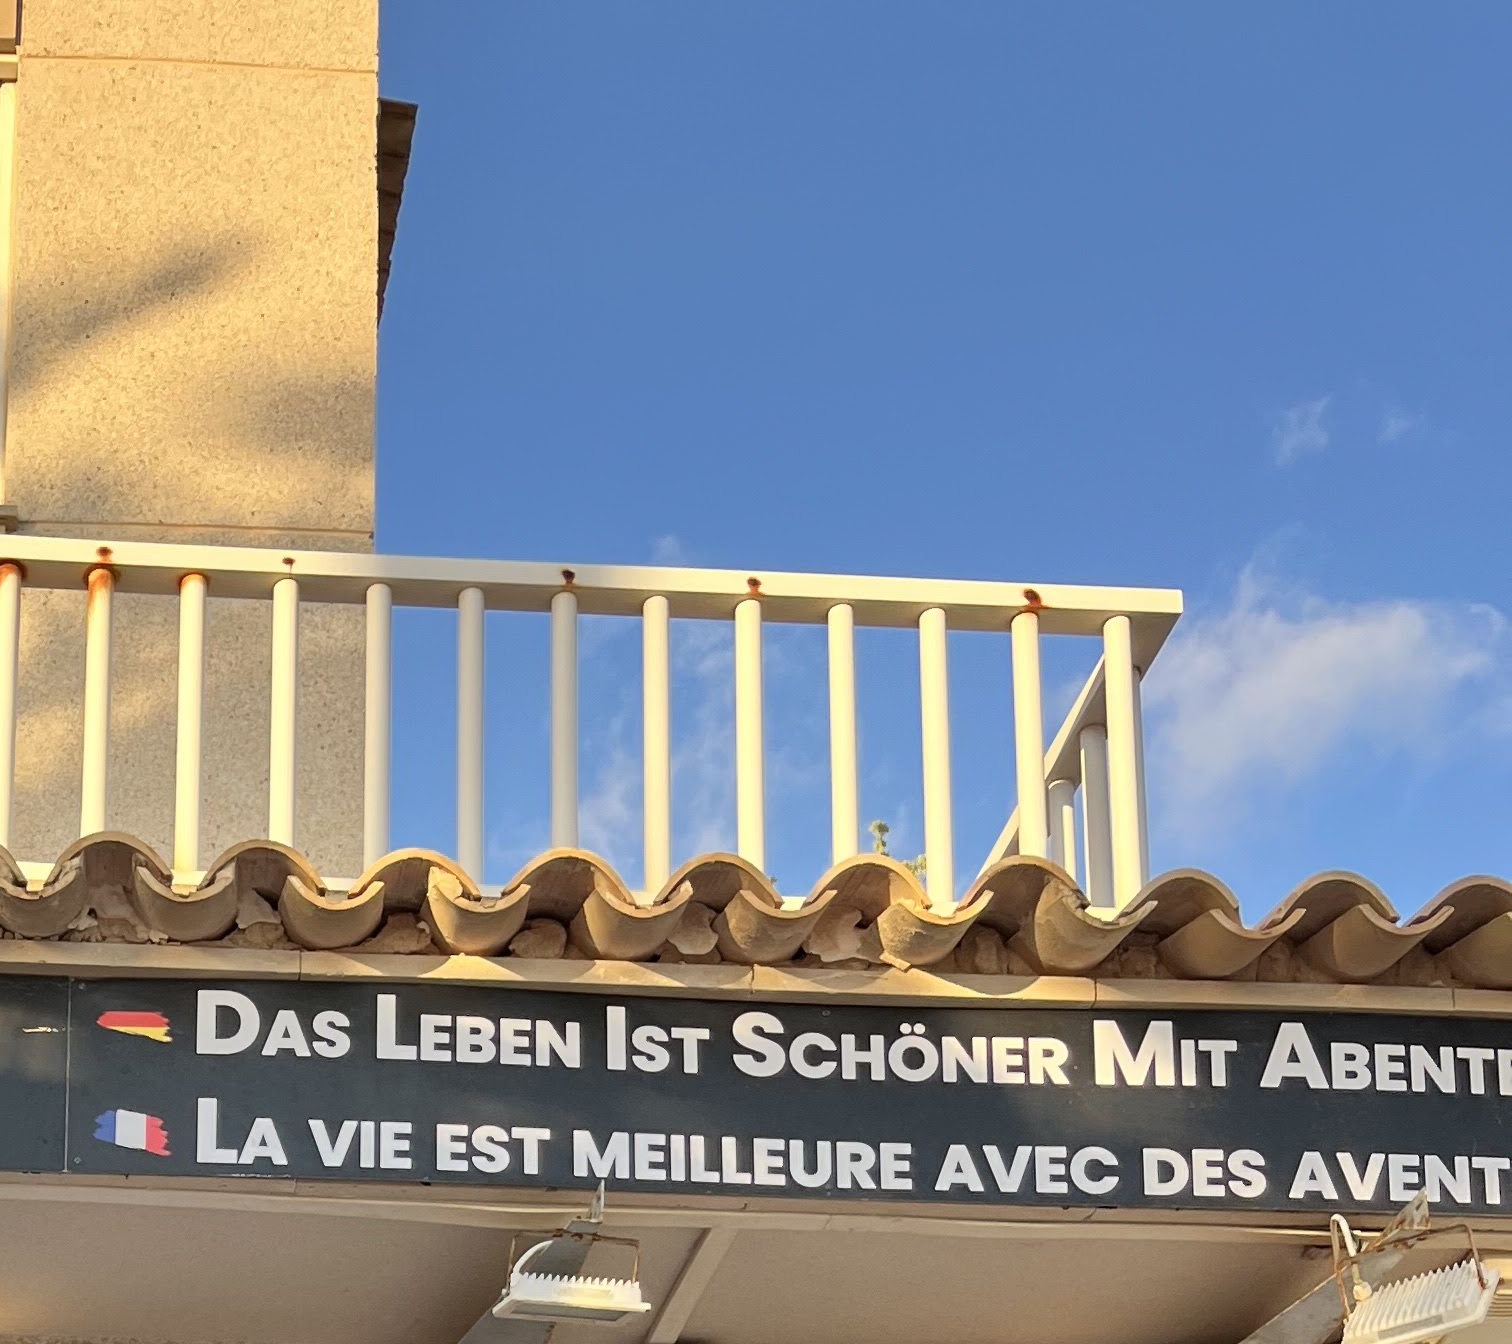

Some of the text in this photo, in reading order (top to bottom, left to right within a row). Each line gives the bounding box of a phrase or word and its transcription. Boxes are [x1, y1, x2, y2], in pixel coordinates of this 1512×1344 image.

[307, 1119, 413, 1170] VIE
[436, 1123, 551, 1175] EST
[572, 1129, 913, 1191] MEILLEURE
[934, 1144, 1120, 1195] AVEC
[1142, 1147, 1267, 1199] DES
